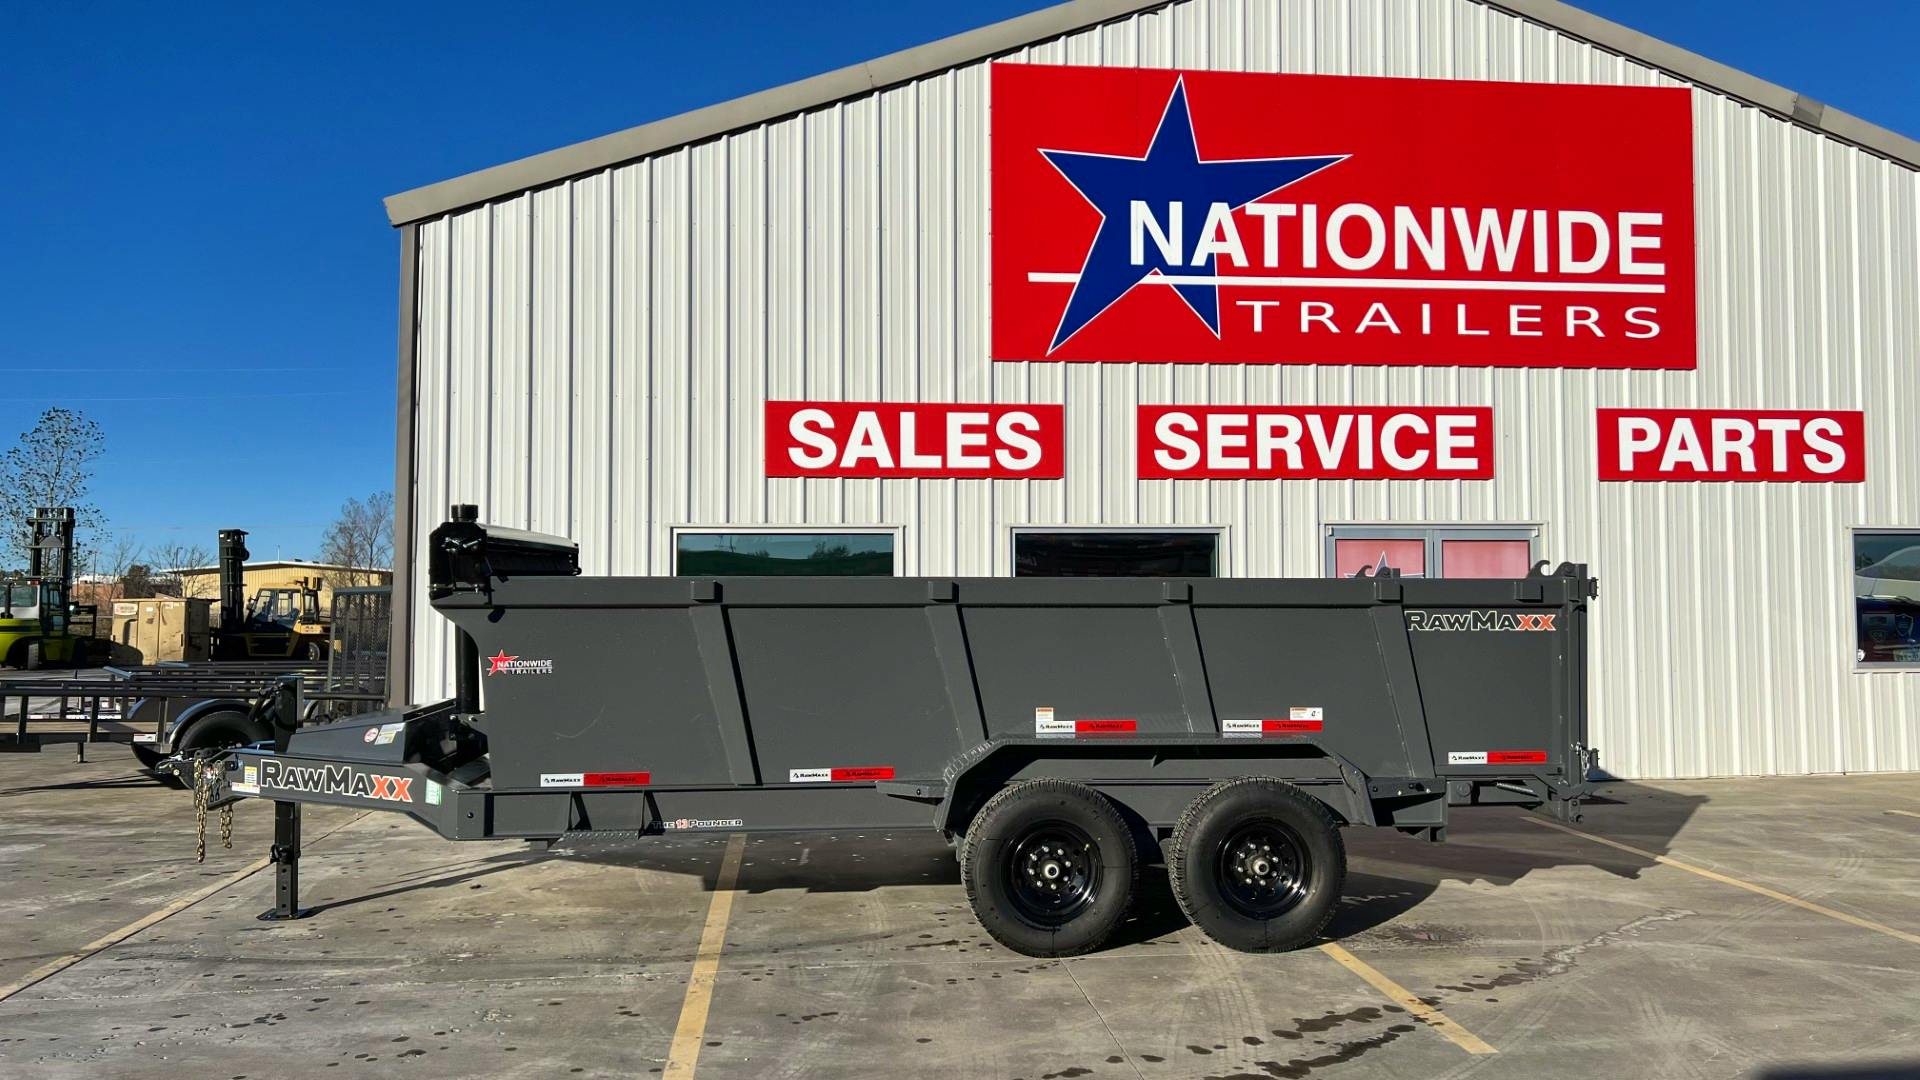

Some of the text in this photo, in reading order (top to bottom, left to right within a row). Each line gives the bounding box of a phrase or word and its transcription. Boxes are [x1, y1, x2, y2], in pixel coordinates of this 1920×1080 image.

[1130, 200, 1666, 276] NATIONWIDE
[1236, 300, 1661, 339] TRAILERS
[788, 409, 1042, 471] SALES
[1153, 412, 1479, 471] SERVICE
[1618, 416, 1846, 474] PARTS
[496, 659, 553, 668] NATIONWIDE
